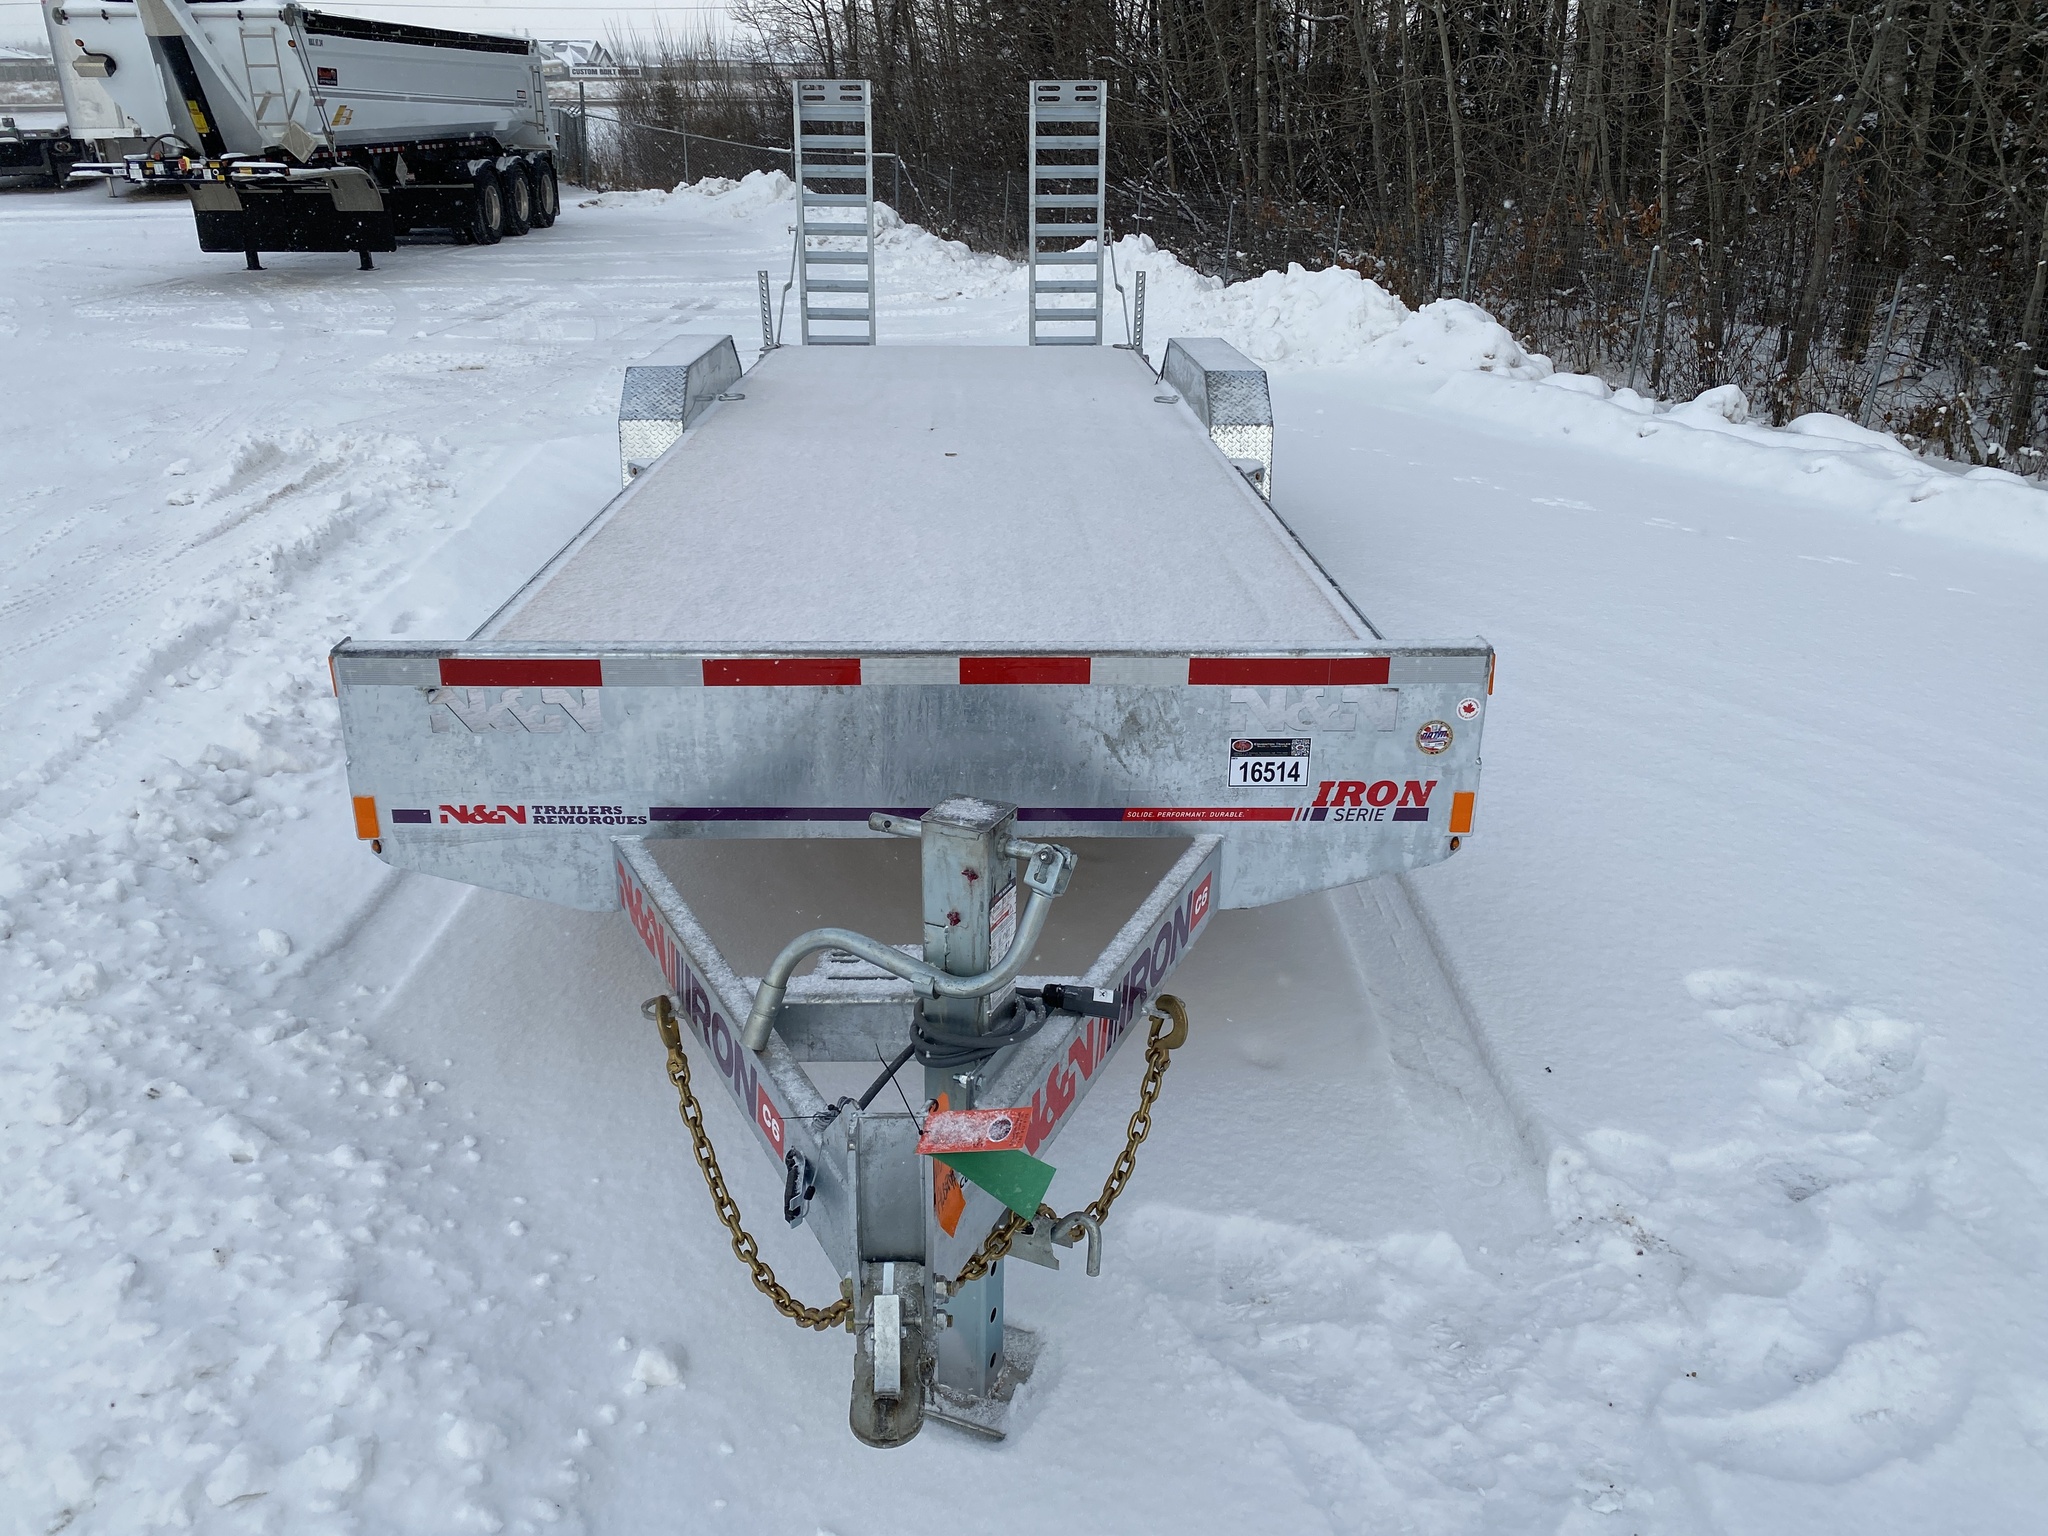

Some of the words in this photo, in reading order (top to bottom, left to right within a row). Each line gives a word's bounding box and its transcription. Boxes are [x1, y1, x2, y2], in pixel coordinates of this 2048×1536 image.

[1239, 761, 1301, 782] 16514
[1312, 780, 1437, 807] IRON
[438, 804, 527, 824] N&N
[531, 805, 623, 815] TRAILERS
[532, 815, 648, 825] REMORQUES
[1333, 807, 1386, 822] SERIE
[685, 962, 758, 1123] IRON
[762, 1103, 780, 1143] C6
